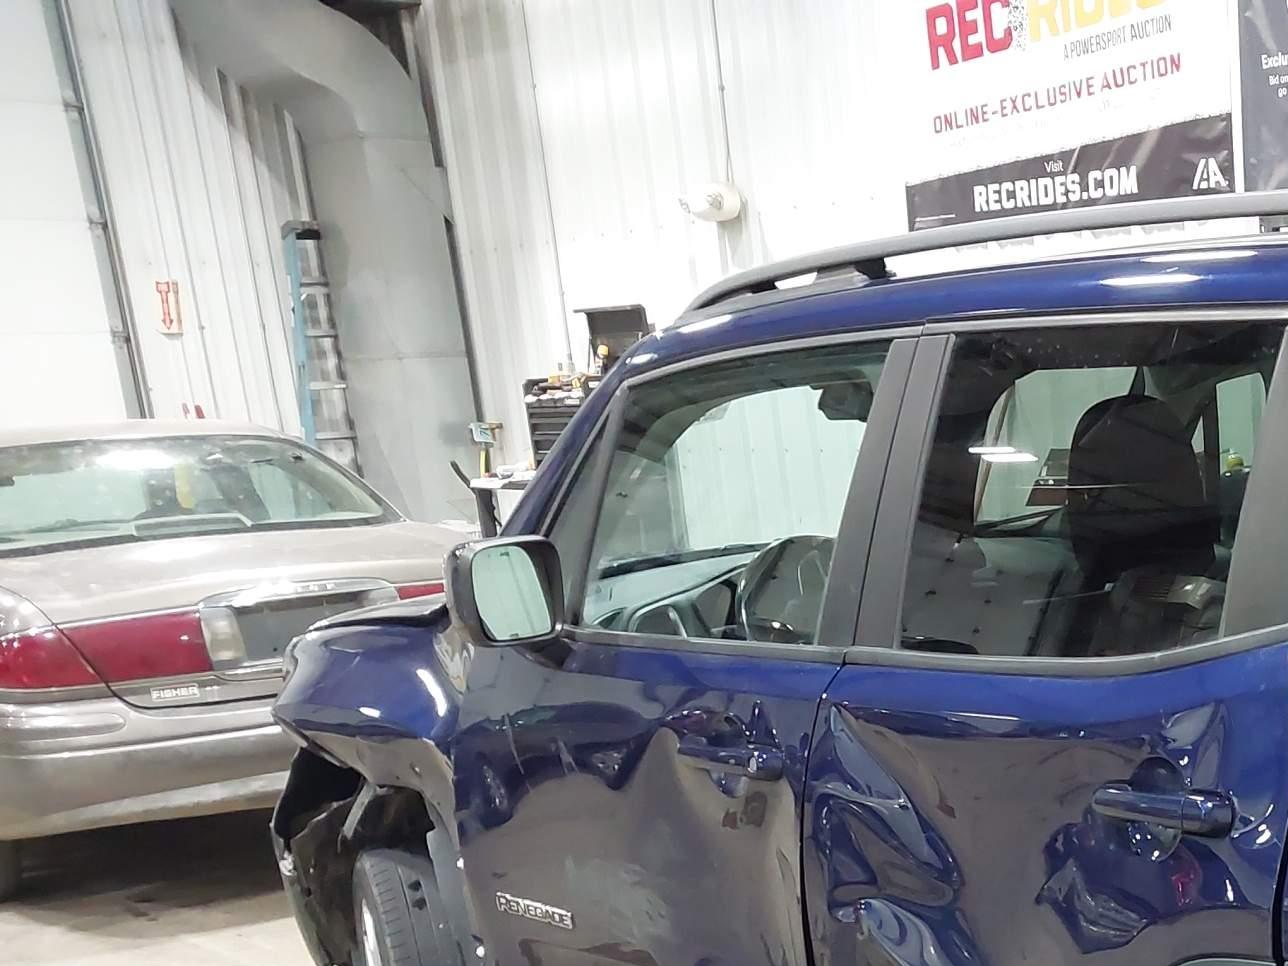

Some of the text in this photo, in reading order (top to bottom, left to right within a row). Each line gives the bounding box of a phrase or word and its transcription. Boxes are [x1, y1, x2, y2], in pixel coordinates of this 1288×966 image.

[926, 0, 1013, 70] REC
[1070, 24, 1127, 58] POWERSPORT
[1129, 13, 1173, 46] AUCTION
[933, 52, 1182, 134] ONLINE-EXCLUSIVE AUCTION
[1268, 75, 1280, 86] Bid
[1280, 74, 1288, 84] on
[1277, 87, 1287, 98] go
[1044, 159, 1064, 173] Visit
[973, 165, 1139, 213] RECRIDES.COM
[496, 891, 573, 929] RENEGADE
